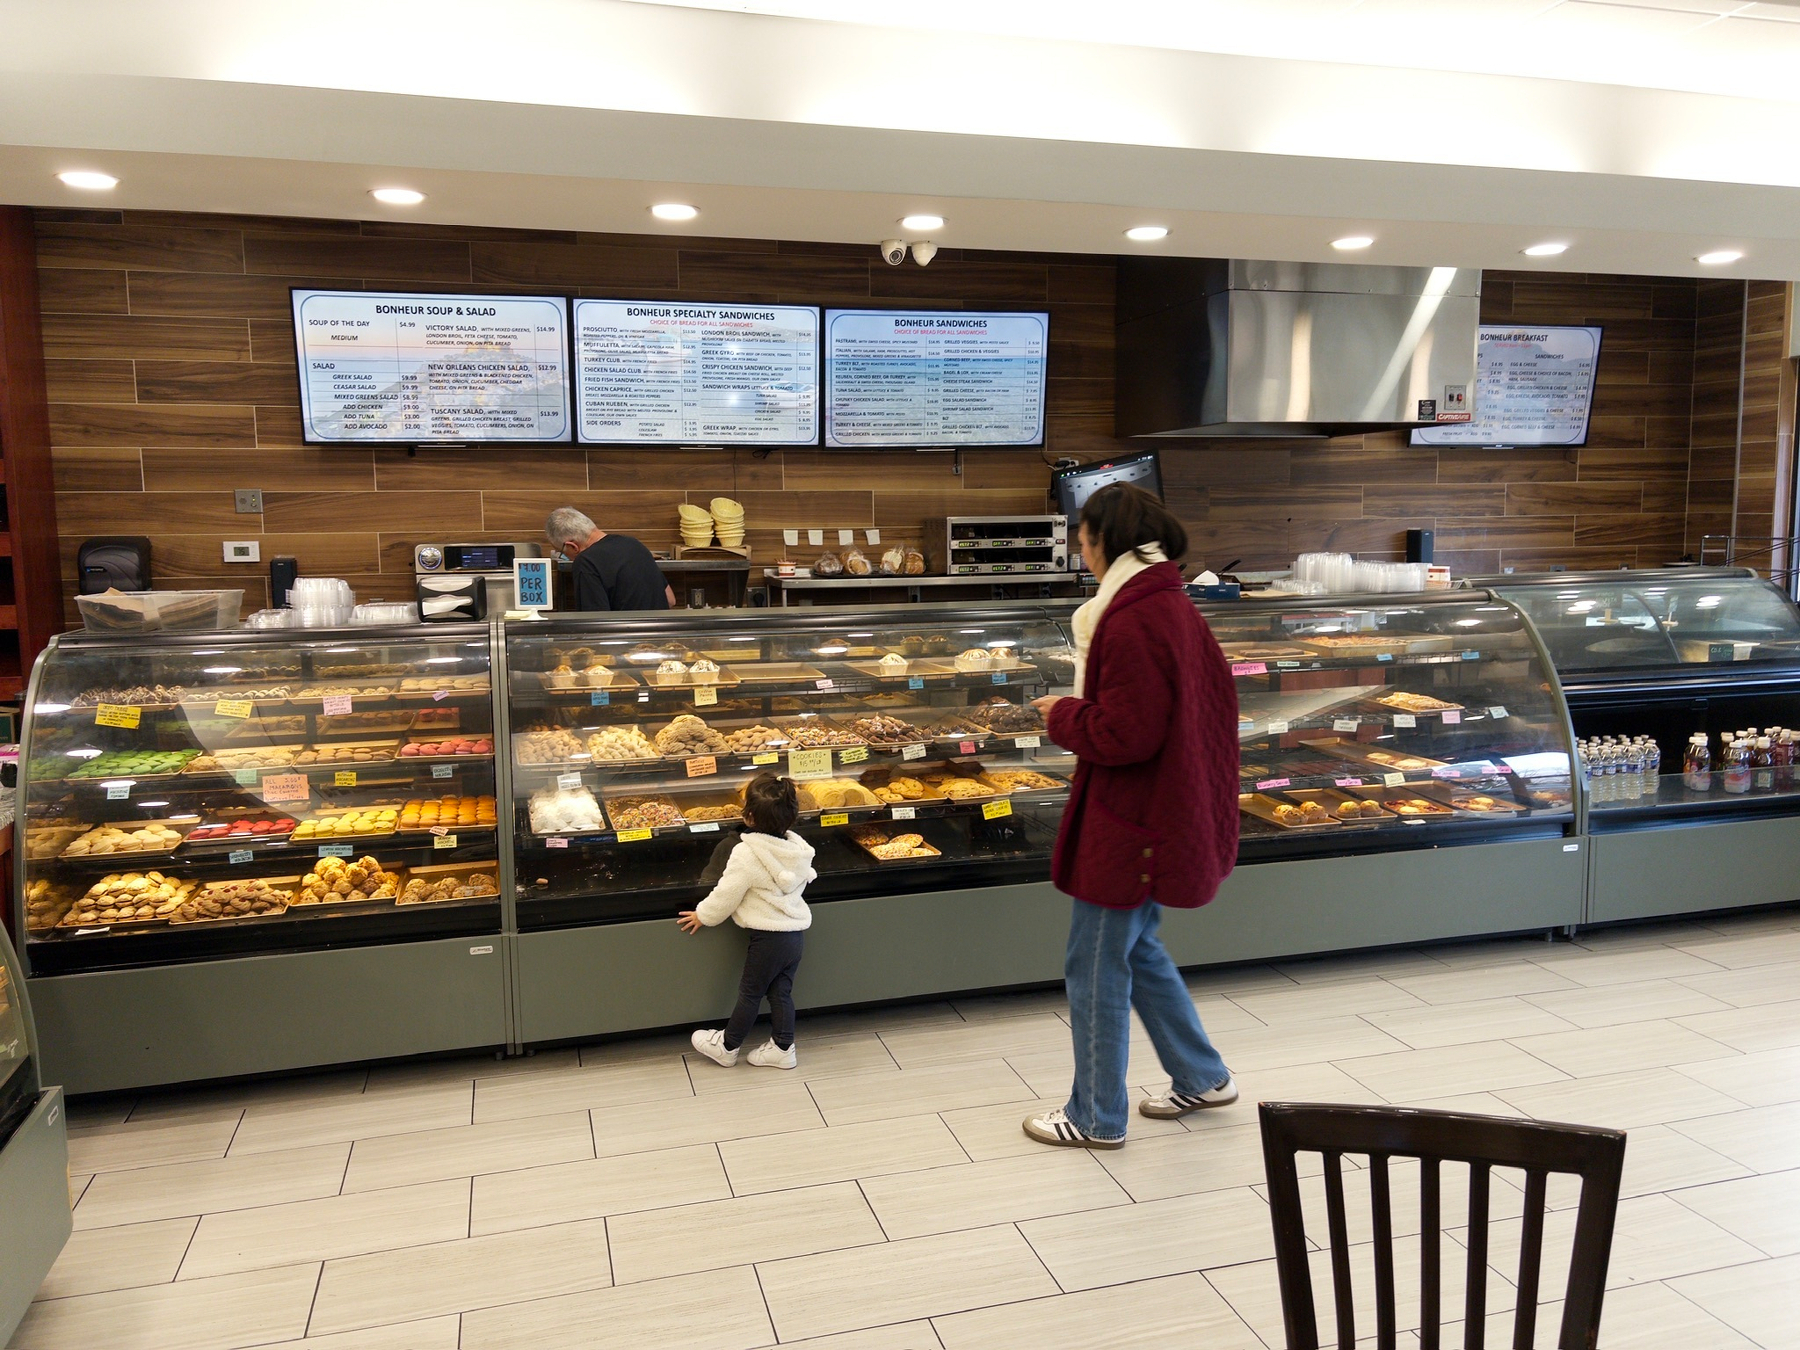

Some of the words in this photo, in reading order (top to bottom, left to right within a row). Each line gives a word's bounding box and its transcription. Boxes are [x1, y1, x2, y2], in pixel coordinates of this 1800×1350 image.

[376, 305, 424, 314] BONHEUR
[427, 306, 453, 315] SOUP
[456, 307, 464, 315] &
[466, 308, 496, 316] SALAD
[627, 308, 672, 318] BONHEUR
[674, 310, 716, 320] SPECIALTY
[719, 312, 775, 320] SANDWICHES
[521, 577, 542, 590] PER
[521, 592, 543, 602] BOX
[796, 752, 822, 760] COOKIES
